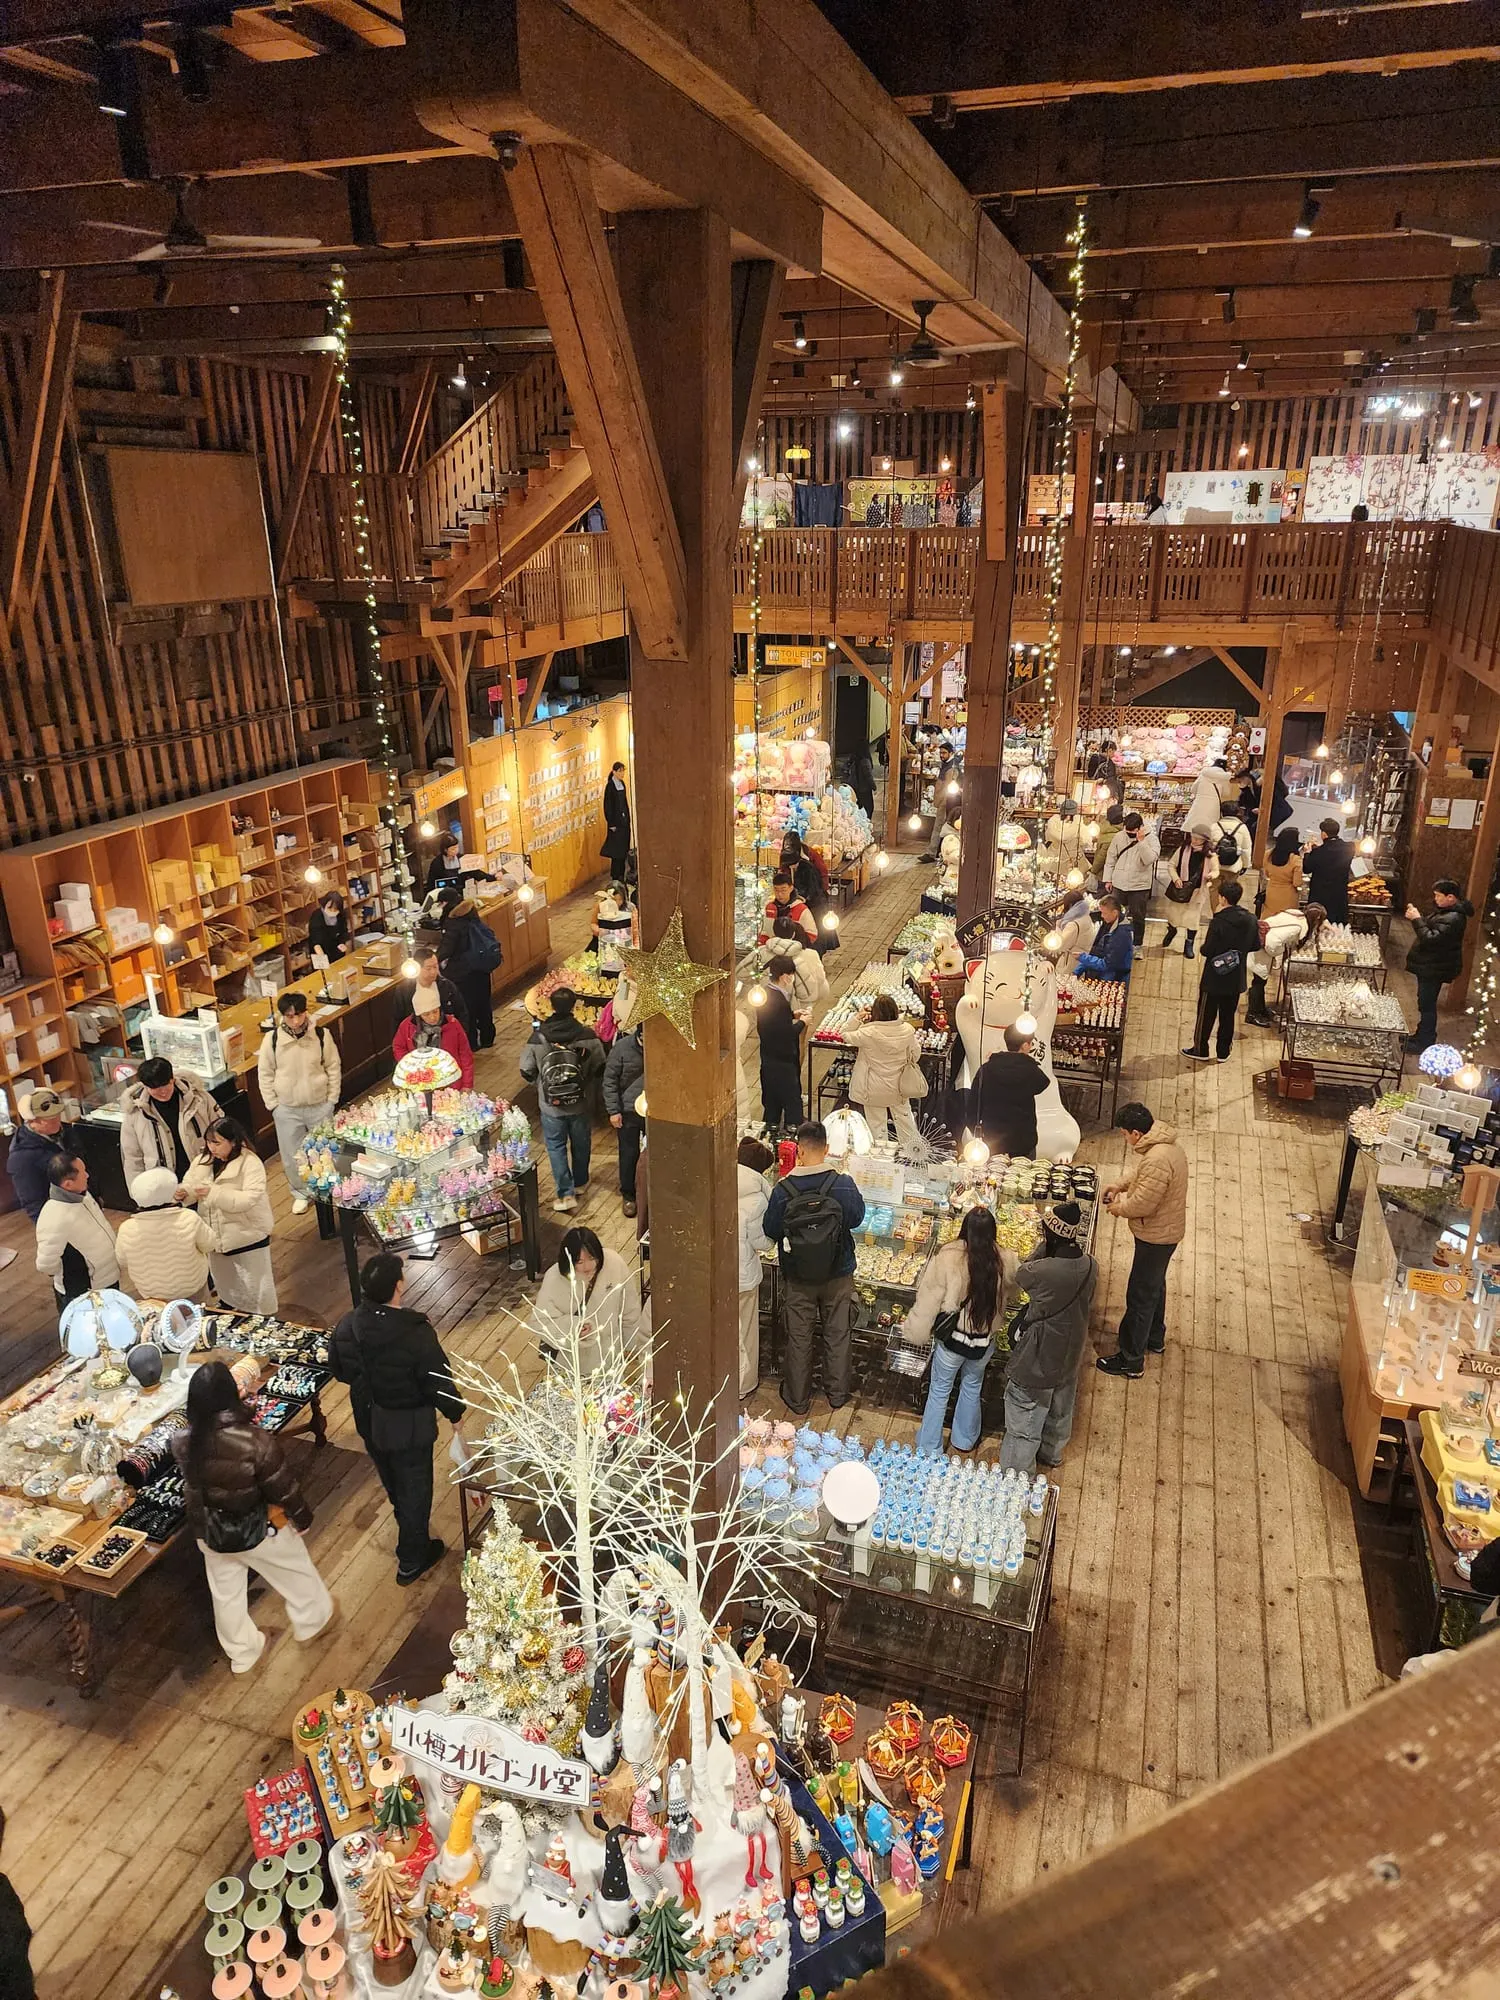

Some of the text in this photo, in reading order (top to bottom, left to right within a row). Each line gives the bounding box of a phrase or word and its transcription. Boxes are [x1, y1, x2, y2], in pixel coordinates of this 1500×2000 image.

[780, 650, 811, 658] TOILET
[430, 777, 461, 798] CASHIER
[400, 1721, 582, 1796] 小樽オルゴール堂
